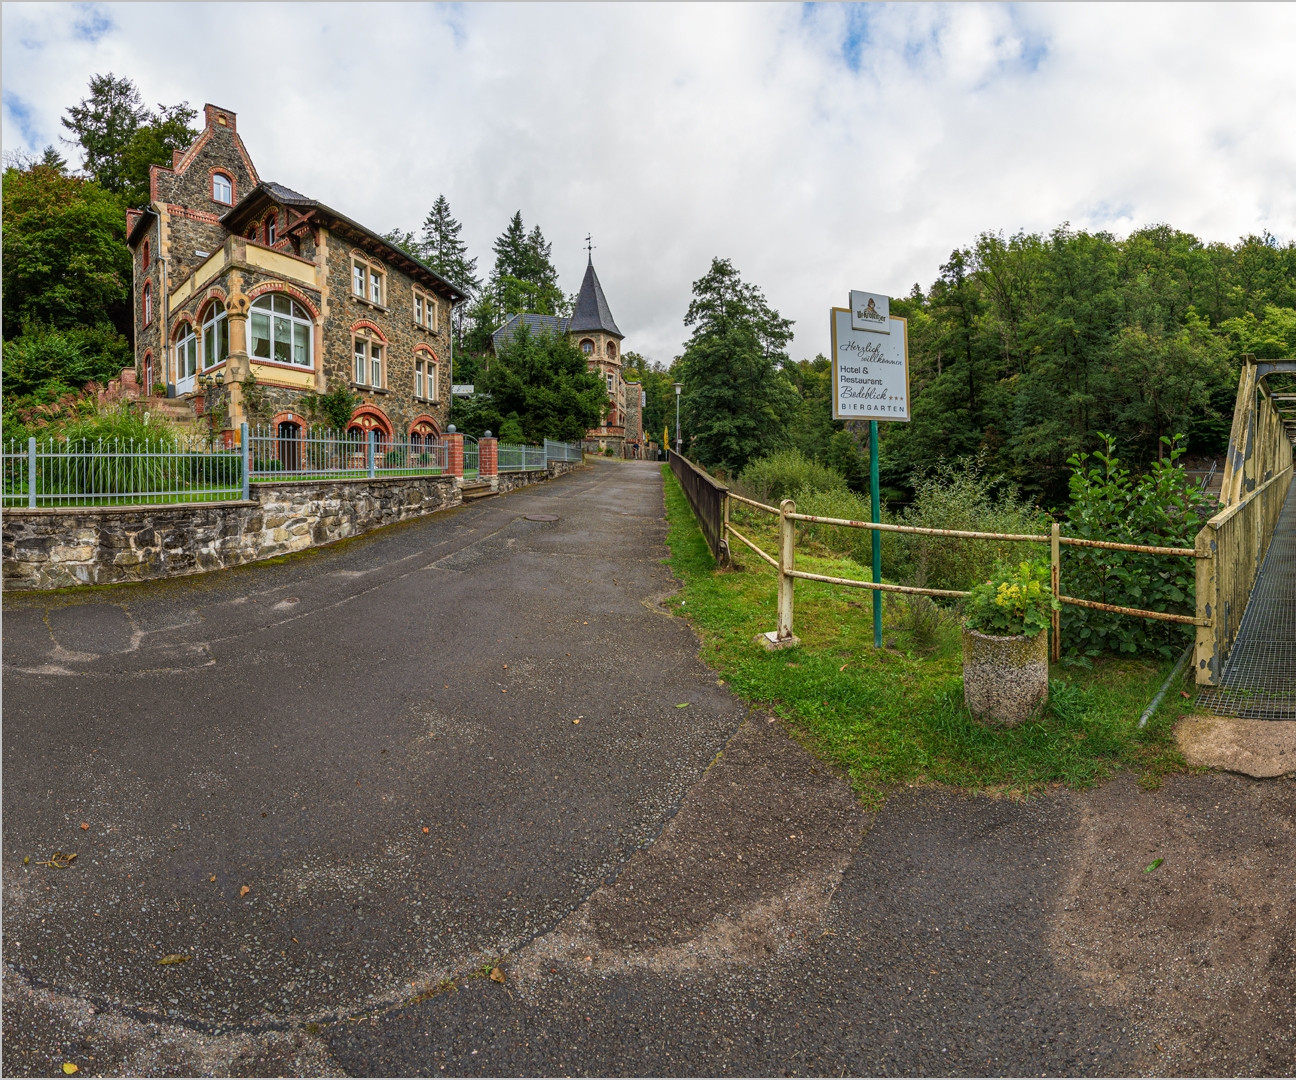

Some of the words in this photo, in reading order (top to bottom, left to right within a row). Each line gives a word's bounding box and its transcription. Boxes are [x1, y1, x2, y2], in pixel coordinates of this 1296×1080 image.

[840, 341, 881, 357] Herzlich
[861, 352, 903, 366] willkommen
[840, 365, 860, 374] Hotel
[862, 366, 869, 375] &
[840, 375, 883, 386] Restaurant
[840, 385, 888, 400] Bodeblick
[841, 403, 905, 413] BIERGARTEN
